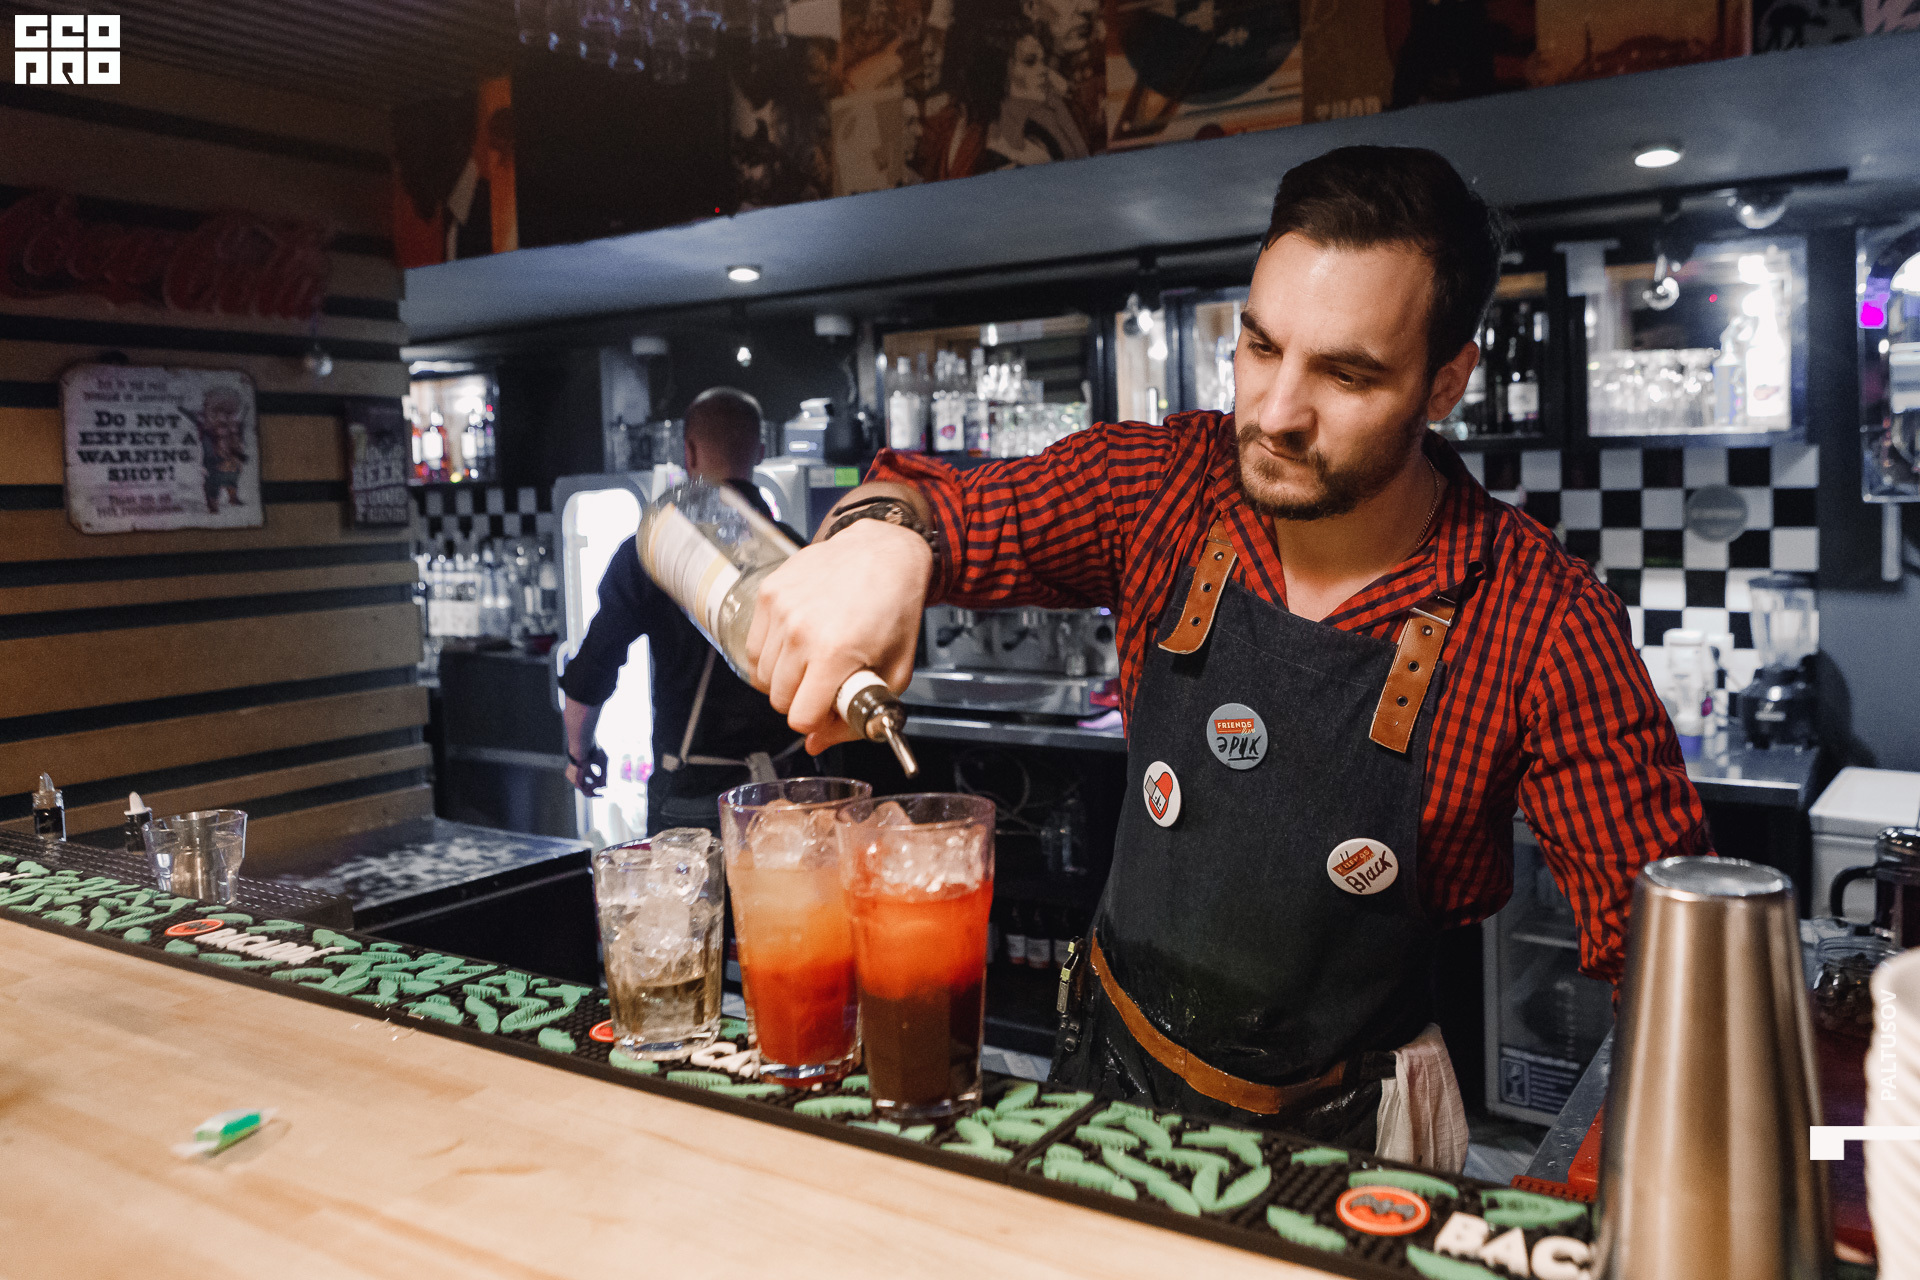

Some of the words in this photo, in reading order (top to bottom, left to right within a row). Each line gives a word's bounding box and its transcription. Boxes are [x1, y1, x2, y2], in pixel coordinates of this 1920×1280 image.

[136, 413, 182, 429] NOT
[79, 431, 170, 446] EXPECT
[182, 431, 198, 446] A
[77, 449, 192, 464] WARNING
[108, 466, 176, 482] SHOT!
[1217, 721, 1252, 729] FRIENDS
[1344, 850, 1393, 893] Black
